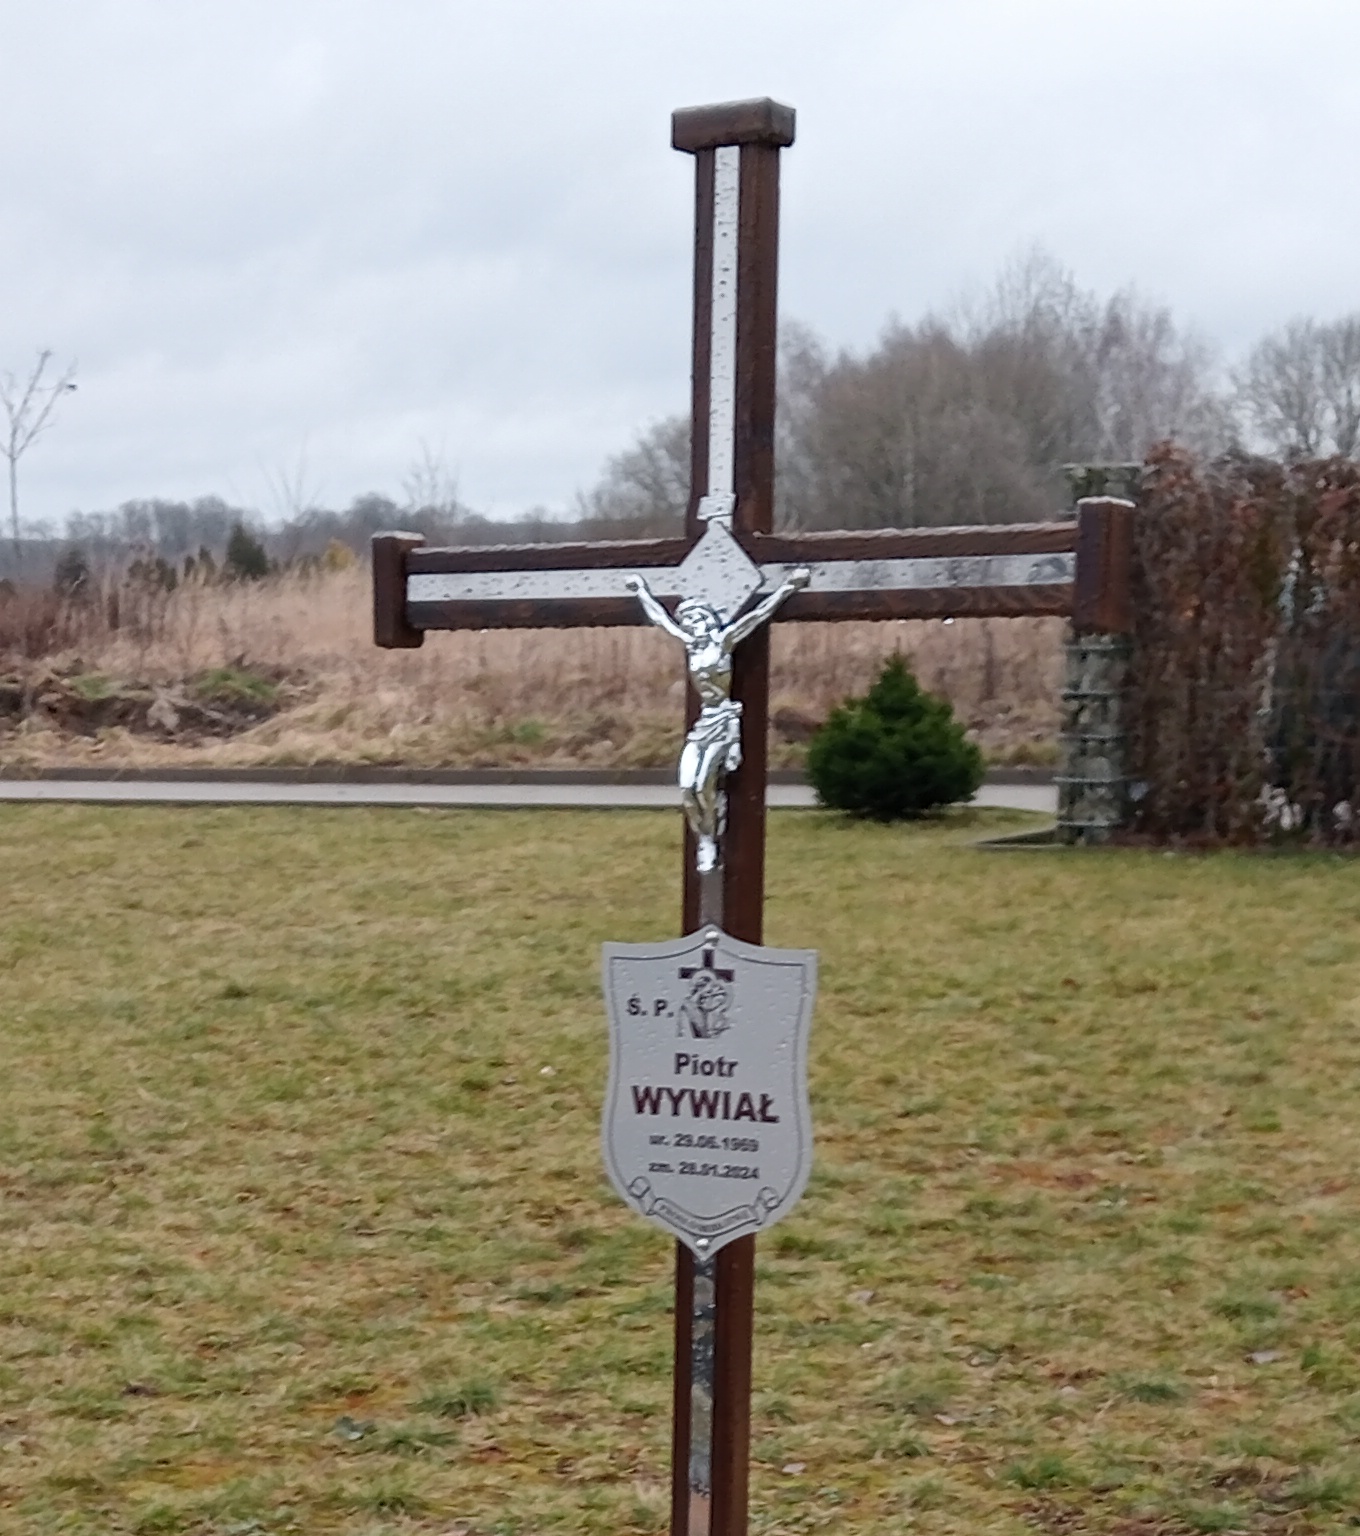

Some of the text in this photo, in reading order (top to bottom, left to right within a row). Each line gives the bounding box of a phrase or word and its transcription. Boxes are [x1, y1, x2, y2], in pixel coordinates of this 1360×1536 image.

[653, 998, 675, 1018] P.
[673, 1051, 739, 1078] Piotr
[631, 1085, 780, 1123] WYWIAŁ
